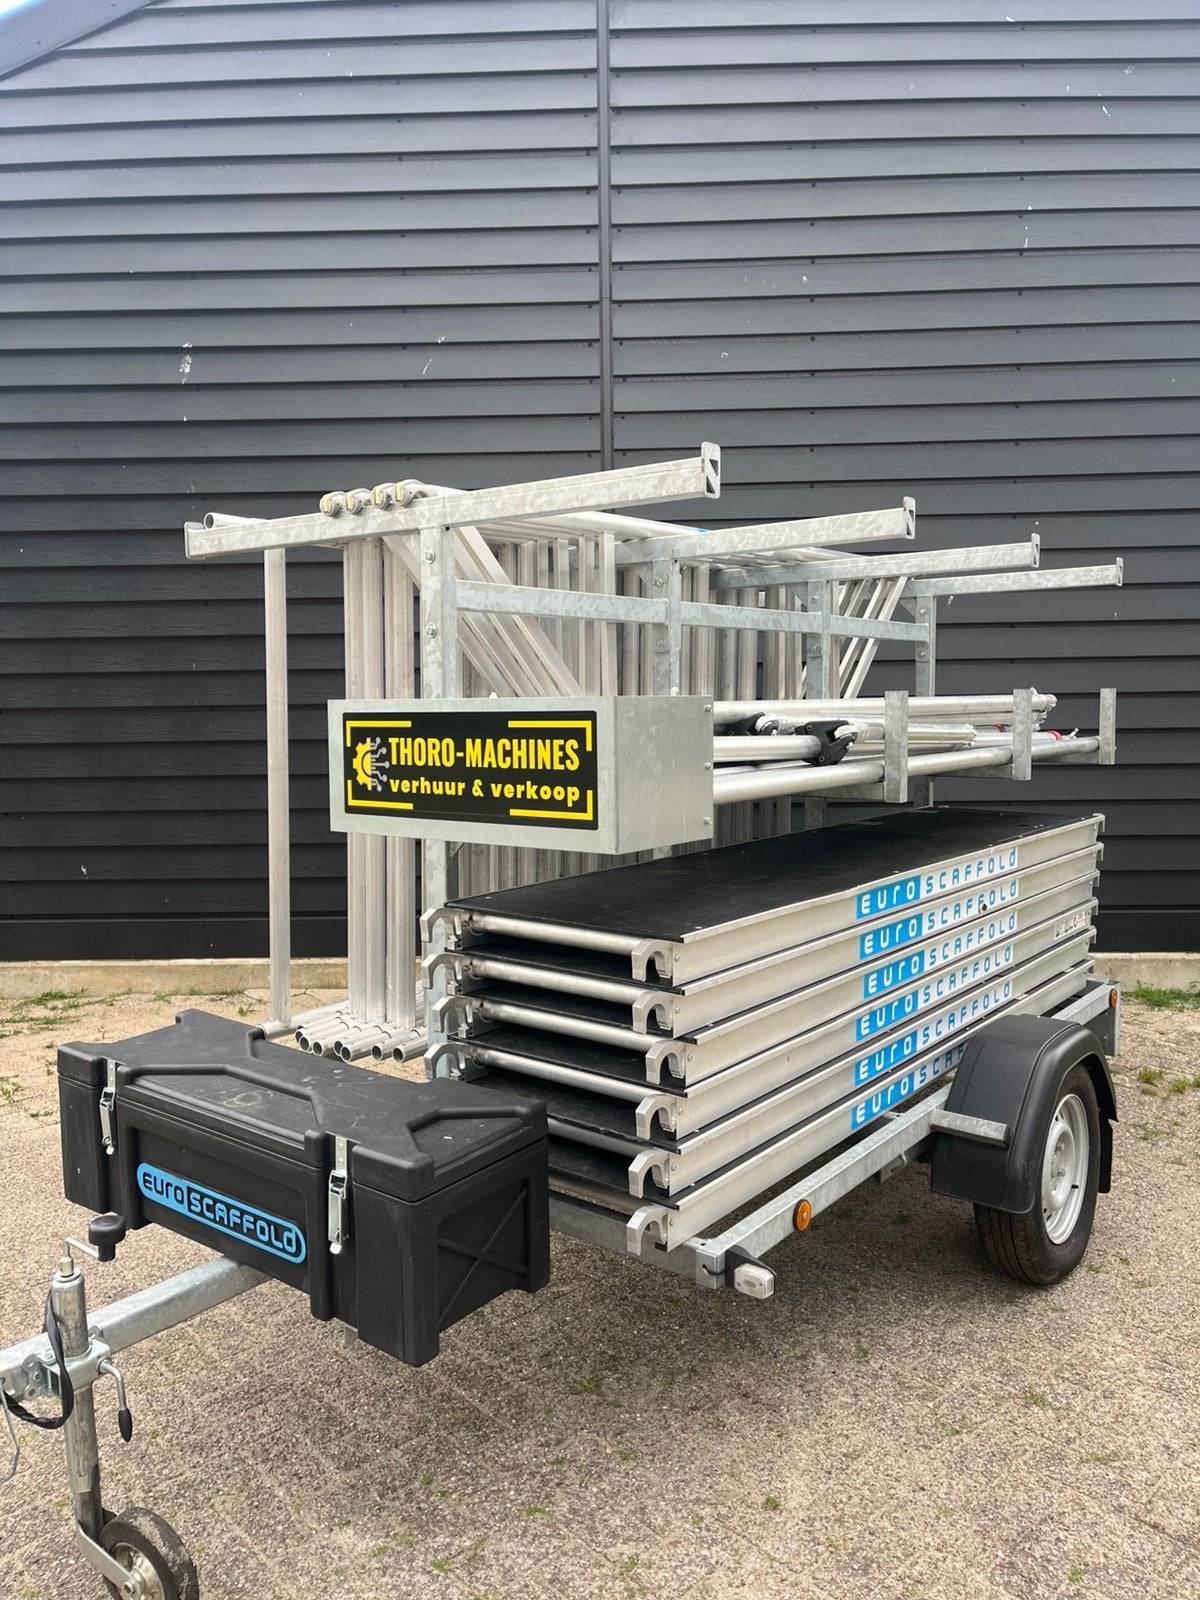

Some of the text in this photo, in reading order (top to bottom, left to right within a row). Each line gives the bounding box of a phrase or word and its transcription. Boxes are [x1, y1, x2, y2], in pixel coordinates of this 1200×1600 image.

[388, 737, 580, 771] THORO-MACHINES
[389, 777, 580, 807] verhuur & verkoop
